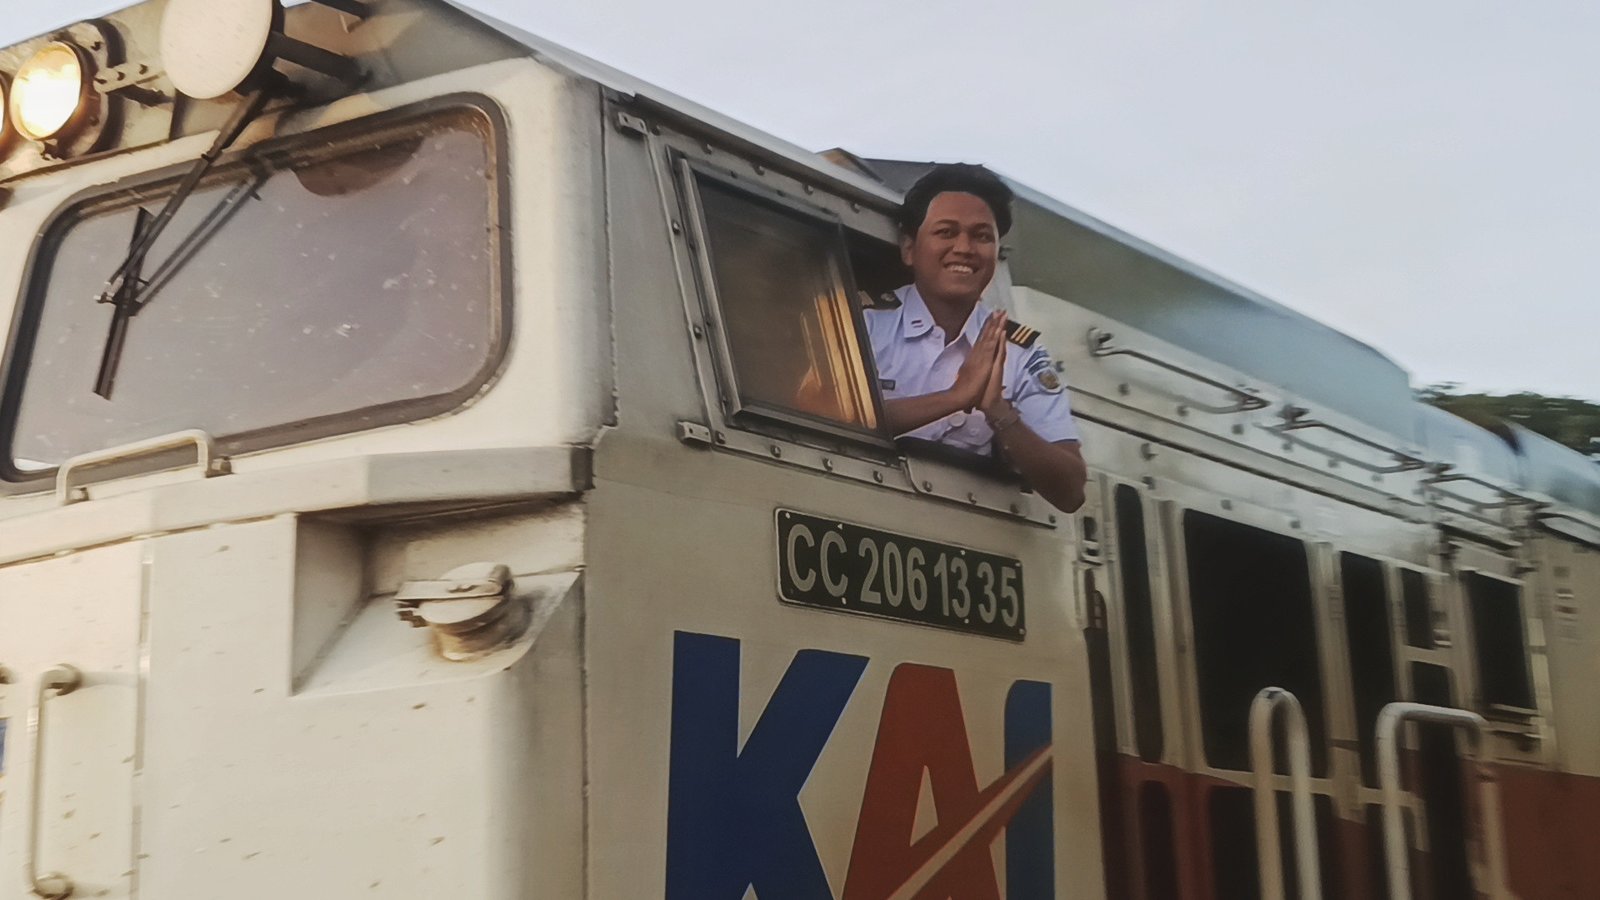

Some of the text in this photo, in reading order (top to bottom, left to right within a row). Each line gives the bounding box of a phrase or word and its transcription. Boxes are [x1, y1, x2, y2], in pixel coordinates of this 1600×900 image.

[787, 523, 849, 598] CC
[858, 537, 928, 612] 206
[664, 630, 1056, 900] KAI
